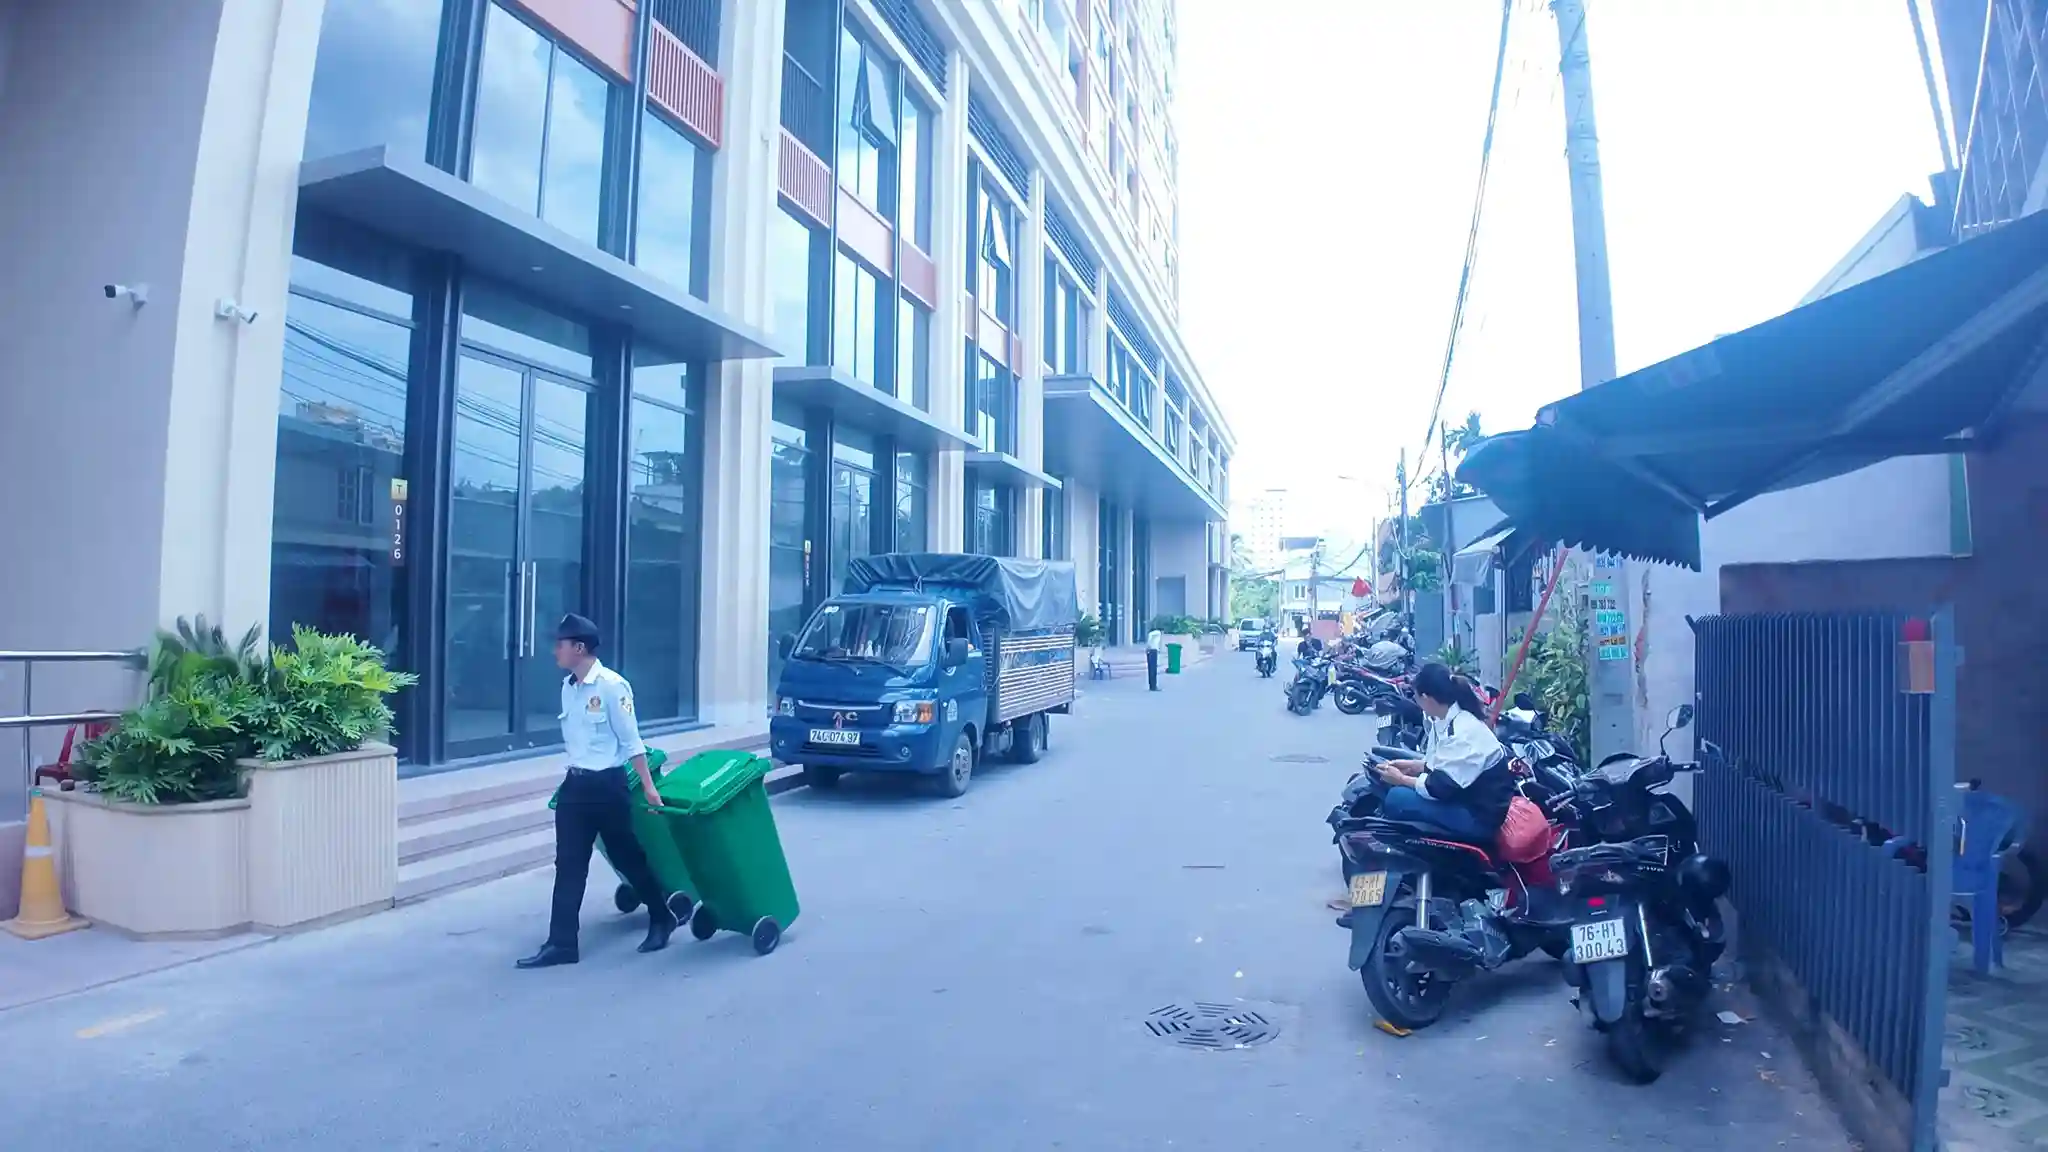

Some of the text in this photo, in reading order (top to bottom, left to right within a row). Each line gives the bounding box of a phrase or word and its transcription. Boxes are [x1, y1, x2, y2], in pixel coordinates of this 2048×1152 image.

[393, 504, 403, 559] 0126
[1579, 922, 1616, 942] 76-H1
[1575, 938, 1625, 960] 300.43
